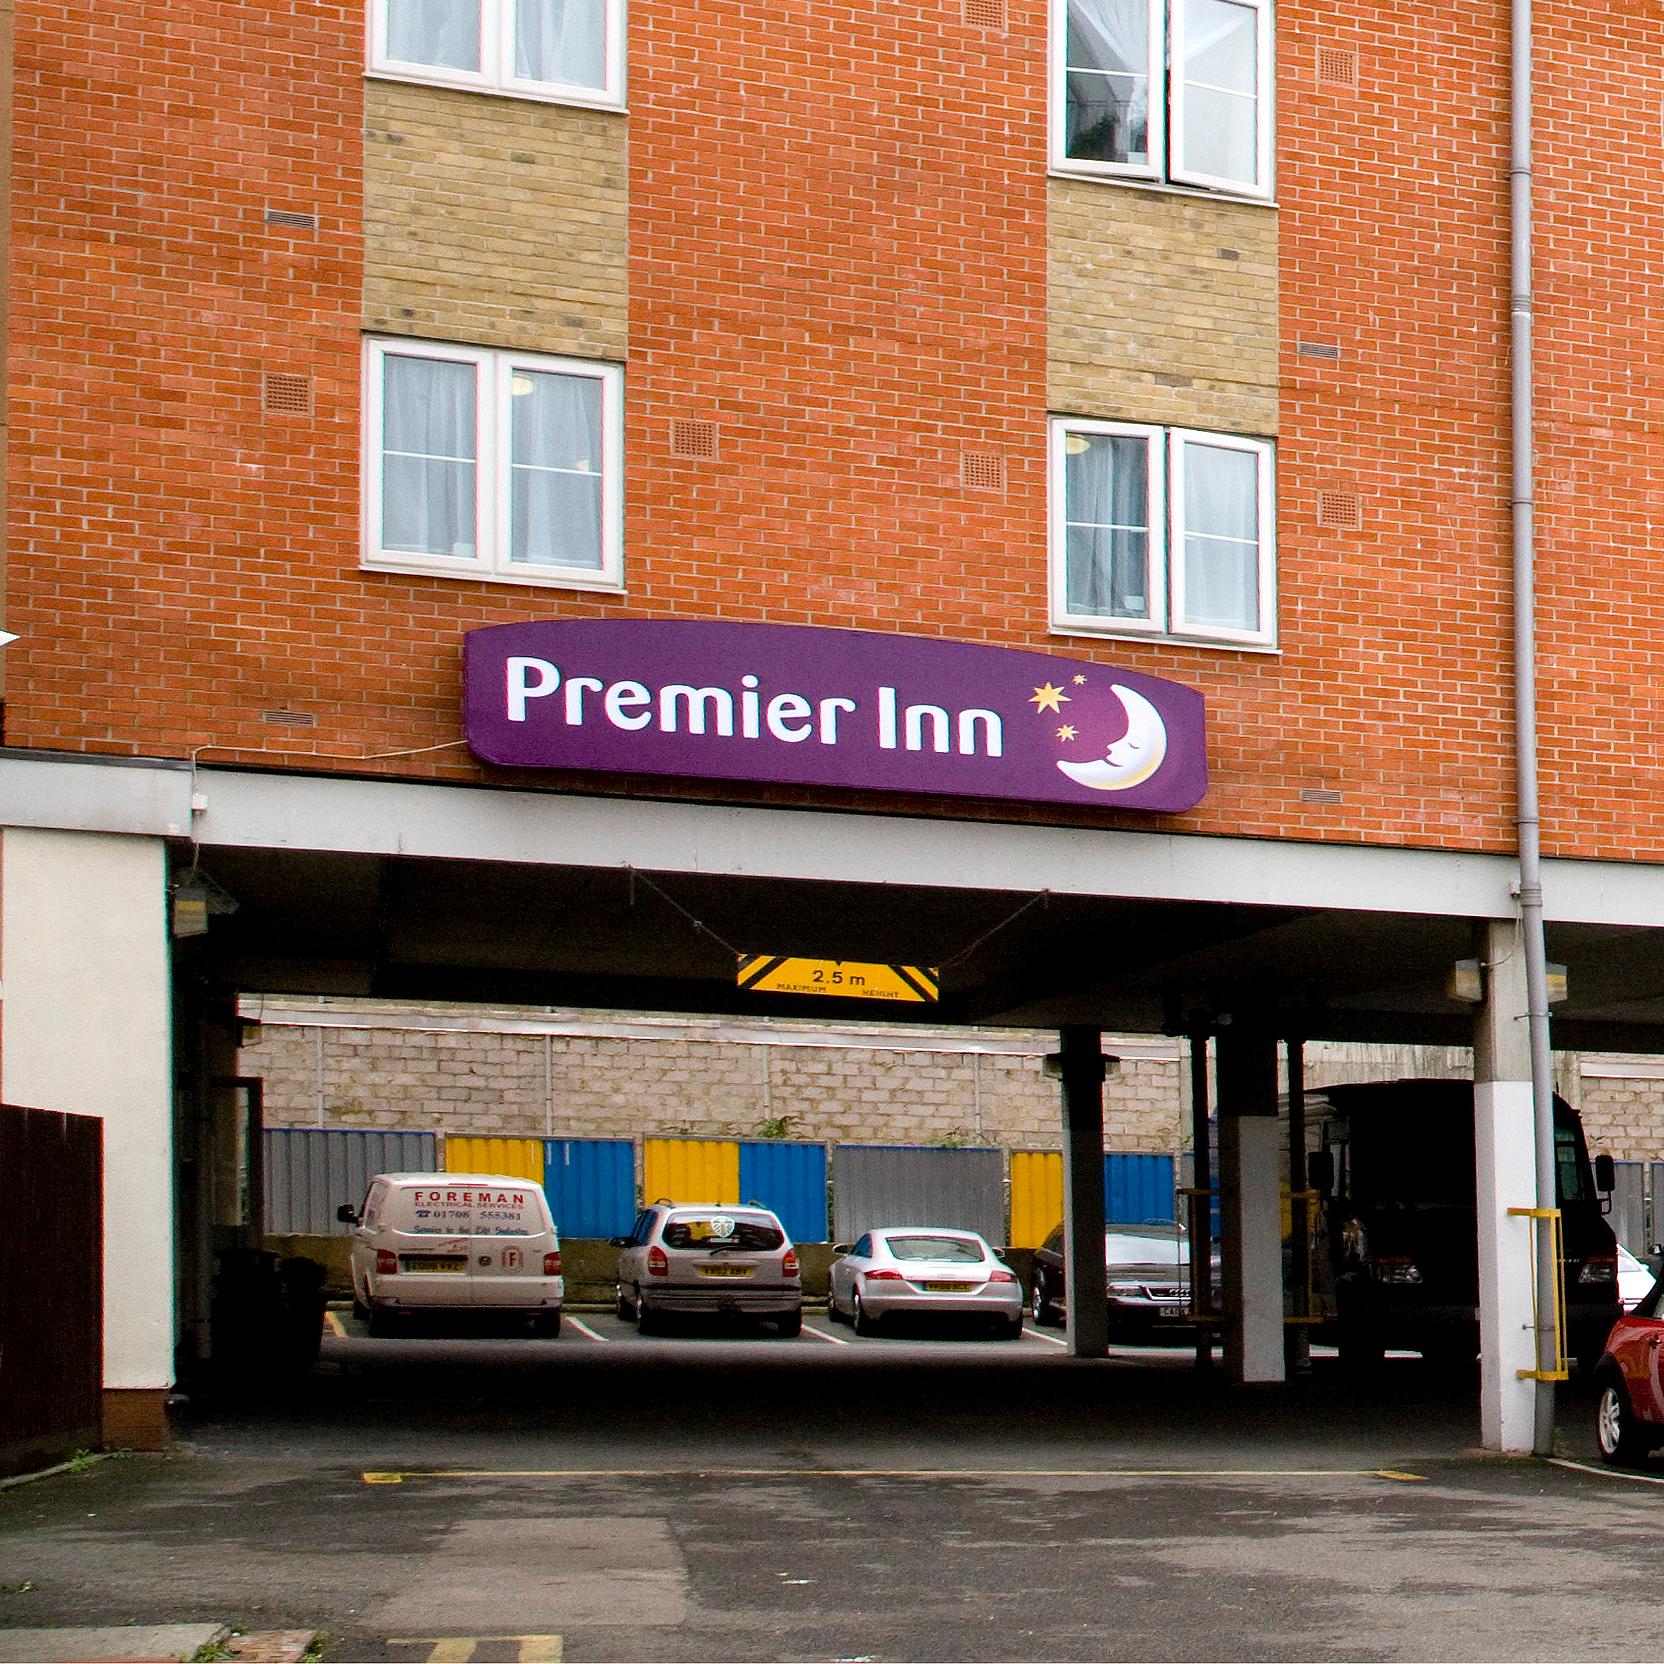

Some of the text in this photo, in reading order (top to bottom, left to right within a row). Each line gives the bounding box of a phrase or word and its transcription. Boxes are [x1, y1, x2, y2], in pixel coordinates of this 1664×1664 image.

[505, 655, 1003, 757] Premier Inn
[813, 969, 865, 986] 2.5 m
[776, 983, 898, 998] MAXIMUM HEIGHT
[414, 1191, 525, 1204] FOREMAN
